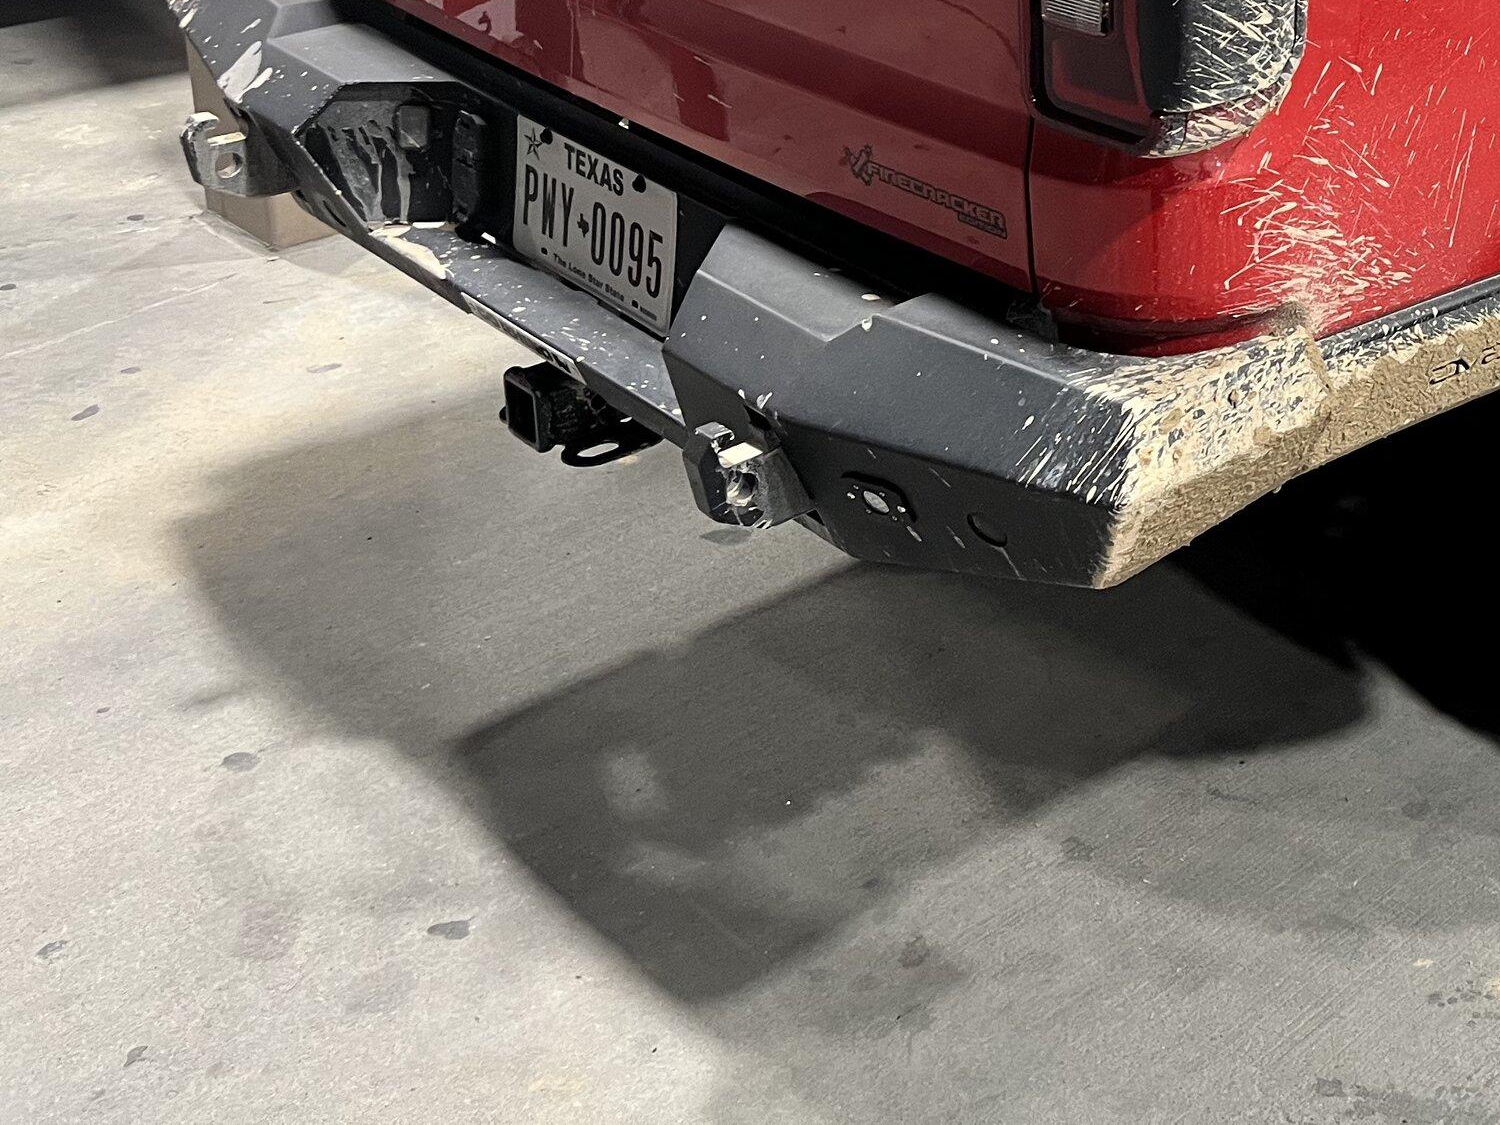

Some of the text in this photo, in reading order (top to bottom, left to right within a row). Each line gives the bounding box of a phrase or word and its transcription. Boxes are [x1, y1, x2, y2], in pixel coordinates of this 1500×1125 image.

[564, 142, 624, 197] TEXAS
[522, 163, 664, 299] PWY 0095
[553, 253, 567, 268] The
